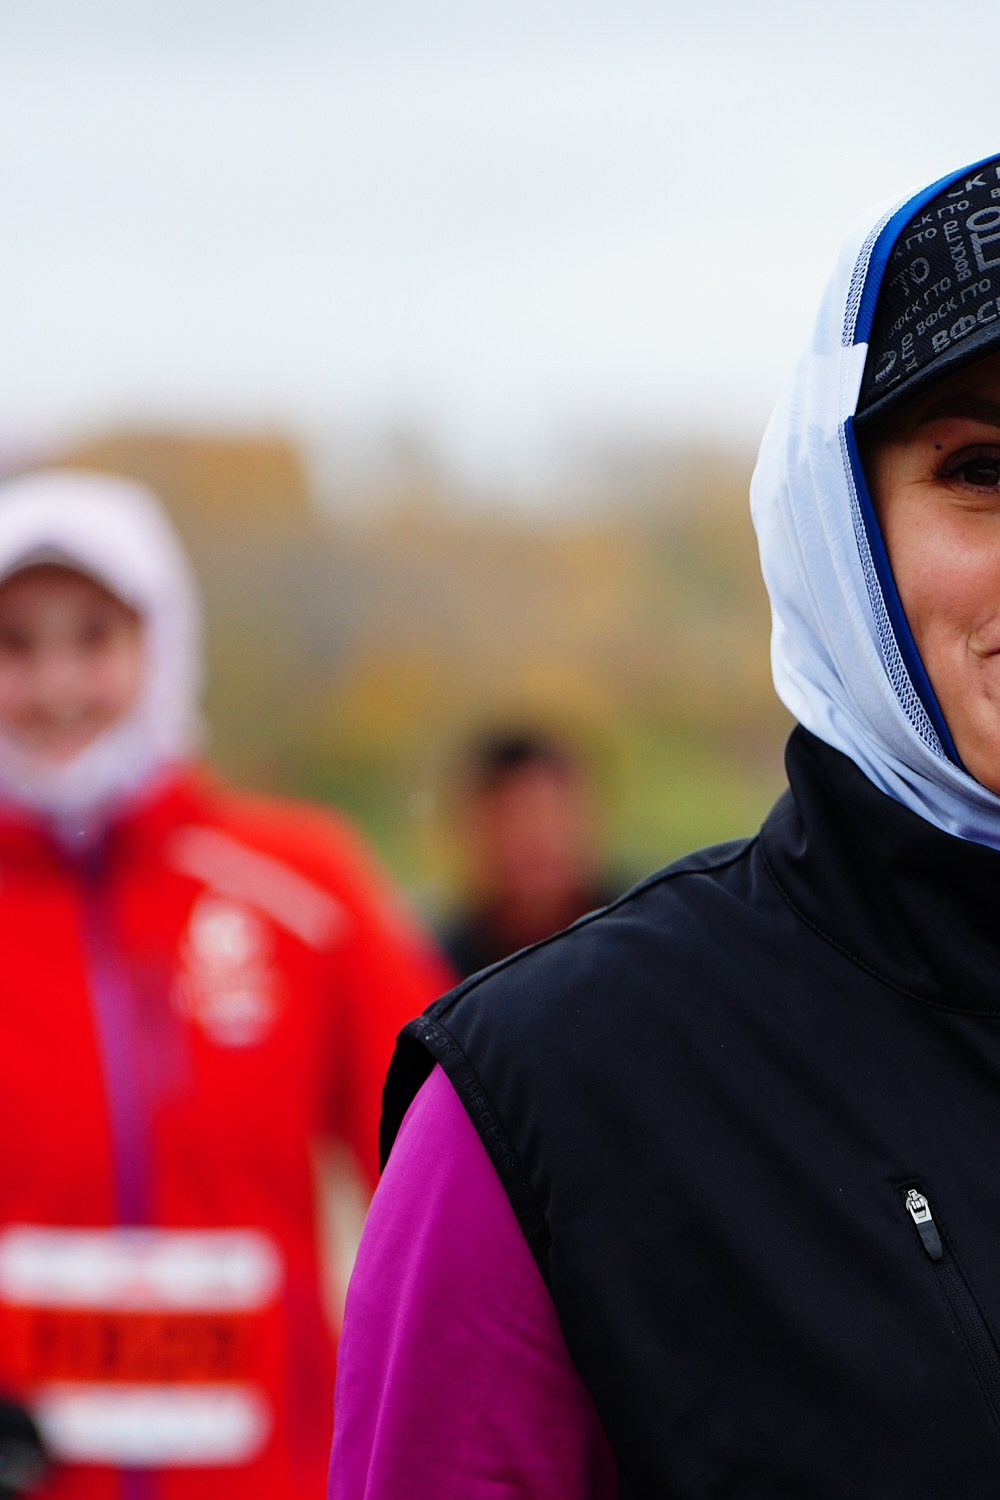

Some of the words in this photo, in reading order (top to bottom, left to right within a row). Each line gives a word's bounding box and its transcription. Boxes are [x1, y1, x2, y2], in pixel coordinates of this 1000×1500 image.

[937, 200, 970, 219] ГТО
[905, 227, 938, 250] ГТО
[915, 296, 959, 336] ВФСК
[960, 278, 992, 304] ГТО
